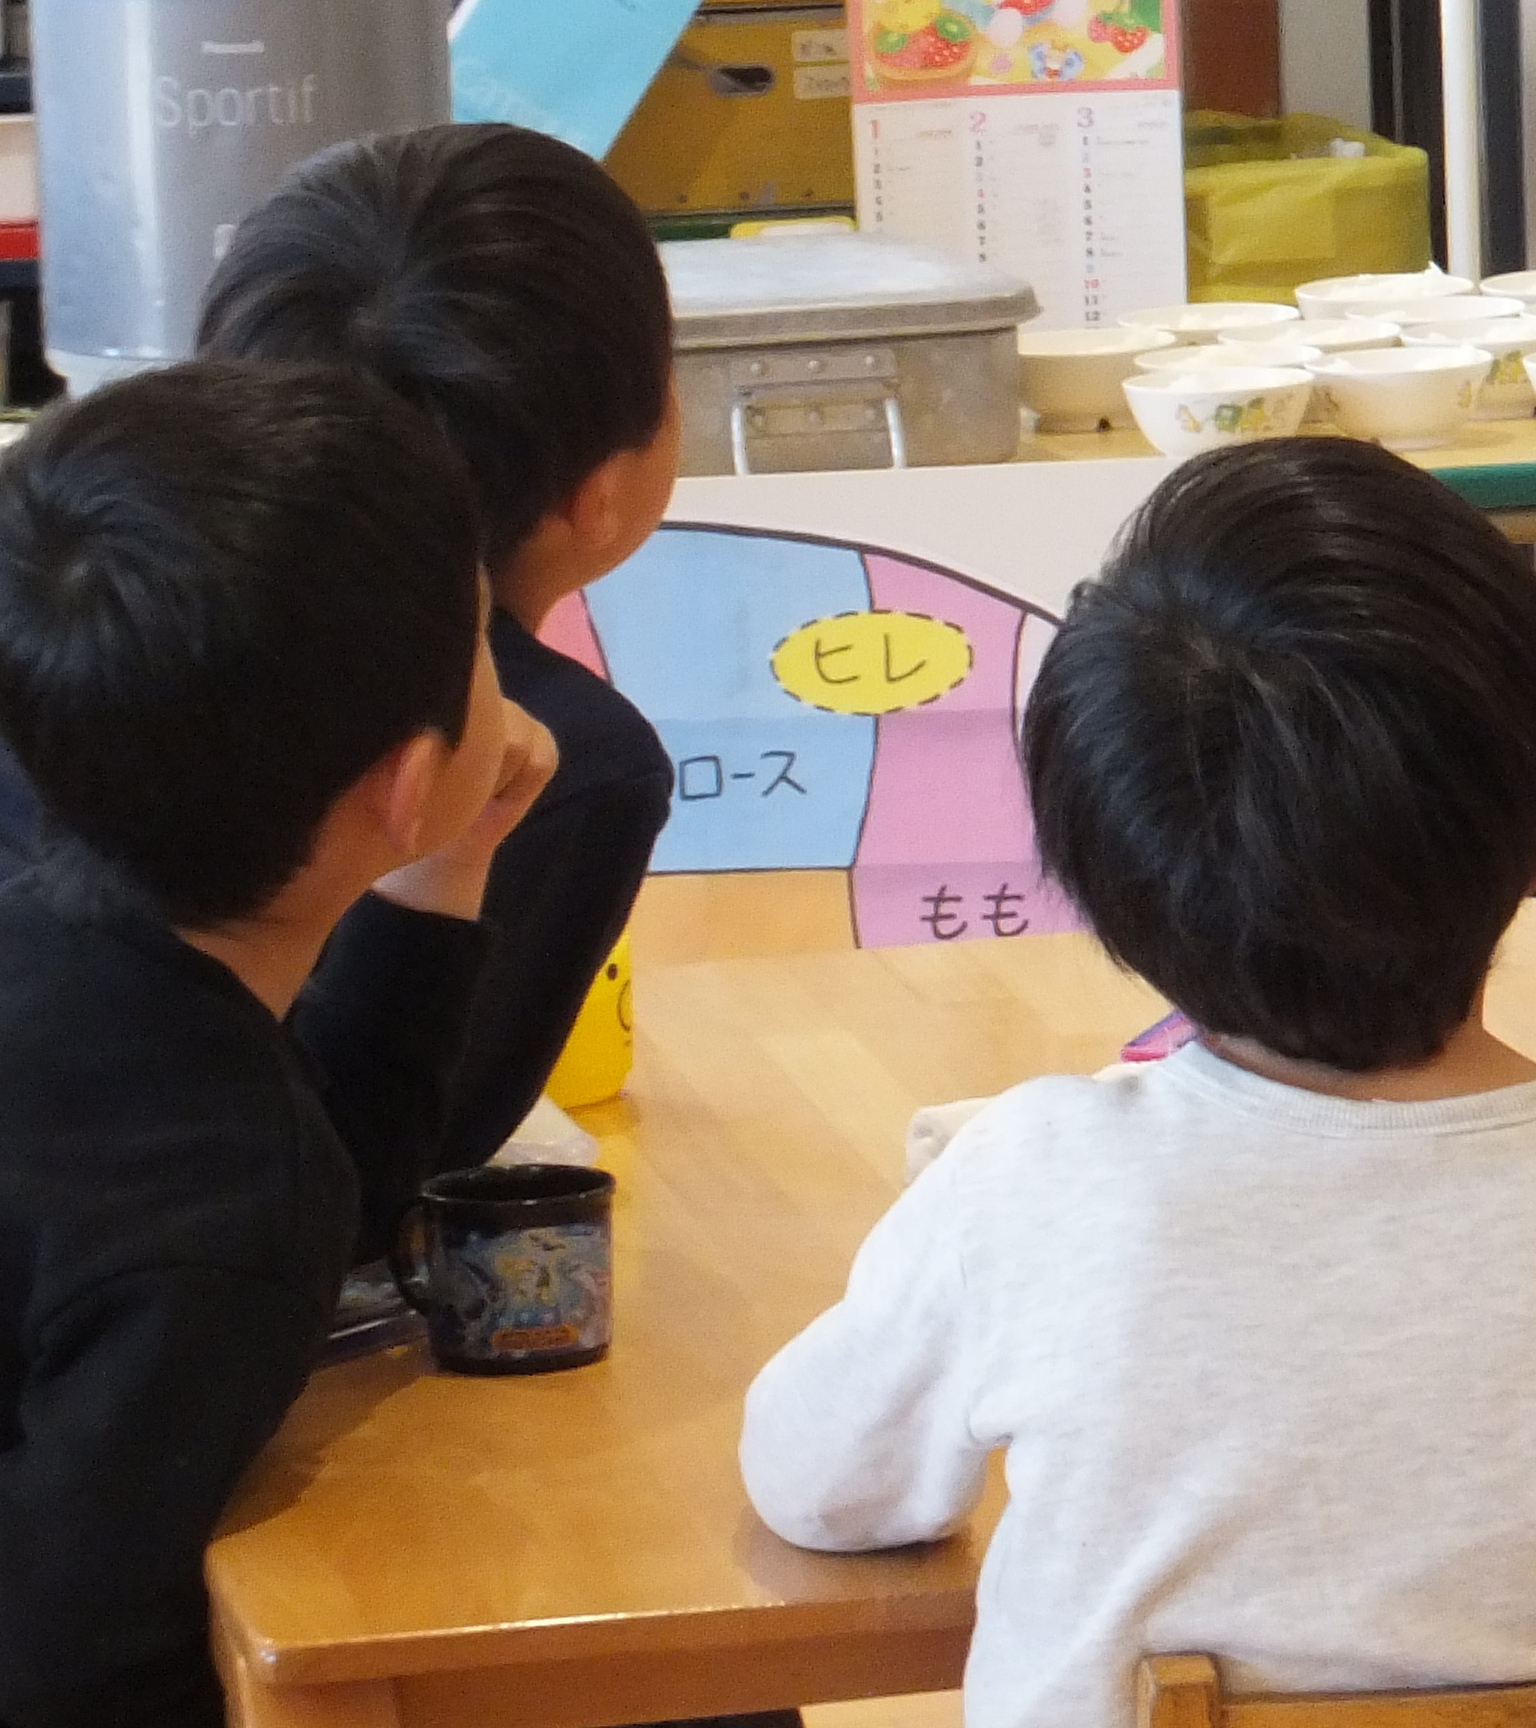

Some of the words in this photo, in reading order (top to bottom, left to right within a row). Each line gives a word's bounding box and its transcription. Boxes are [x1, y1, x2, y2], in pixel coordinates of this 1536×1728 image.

[154, 74, 317, 139] Sportif
[969, 112, 988, 133] 2
[1077, 107, 1095, 129] 3
[812, 633, 927, 685] ヒレ
[679, 750, 807, 801] ロース
[920, 883, 1030, 941] もも
